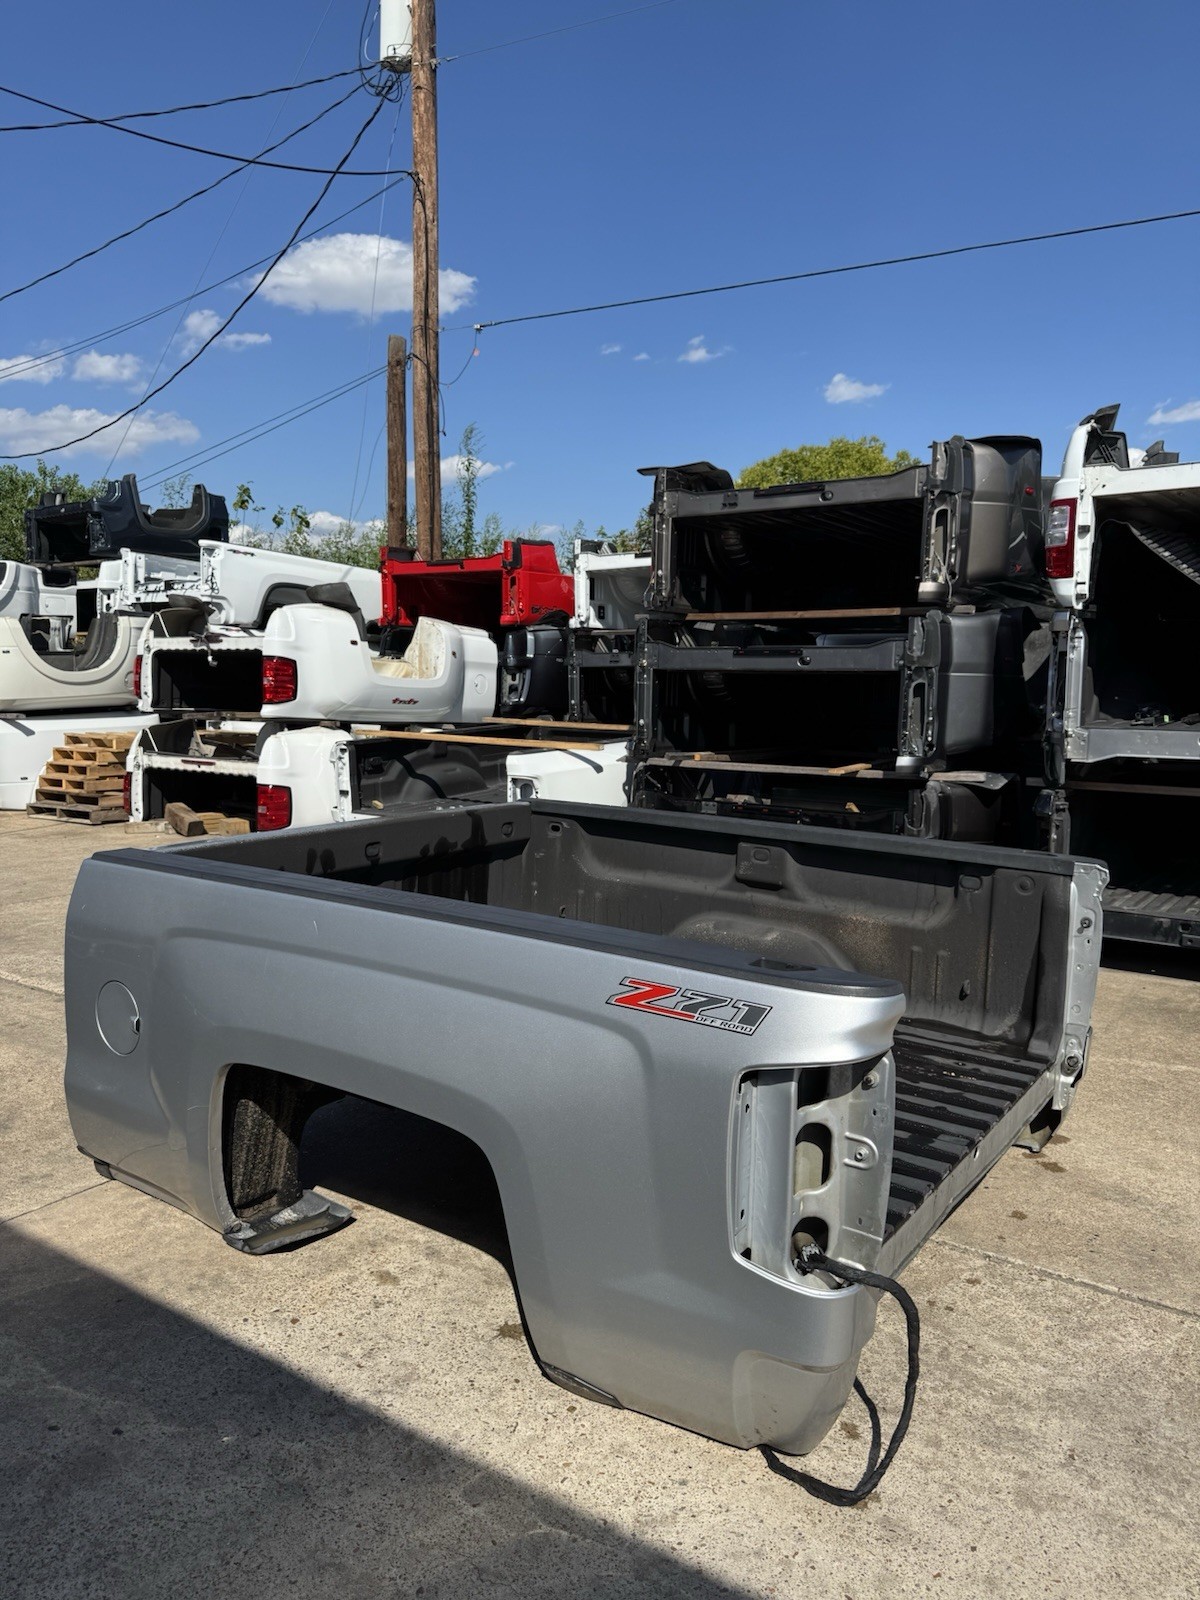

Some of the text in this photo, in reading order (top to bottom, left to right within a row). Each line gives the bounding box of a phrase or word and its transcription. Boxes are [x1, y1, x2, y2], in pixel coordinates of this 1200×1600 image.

[605, 976, 773, 1034] Z71
[695, 1015, 753, 1033] OFF ROAD
